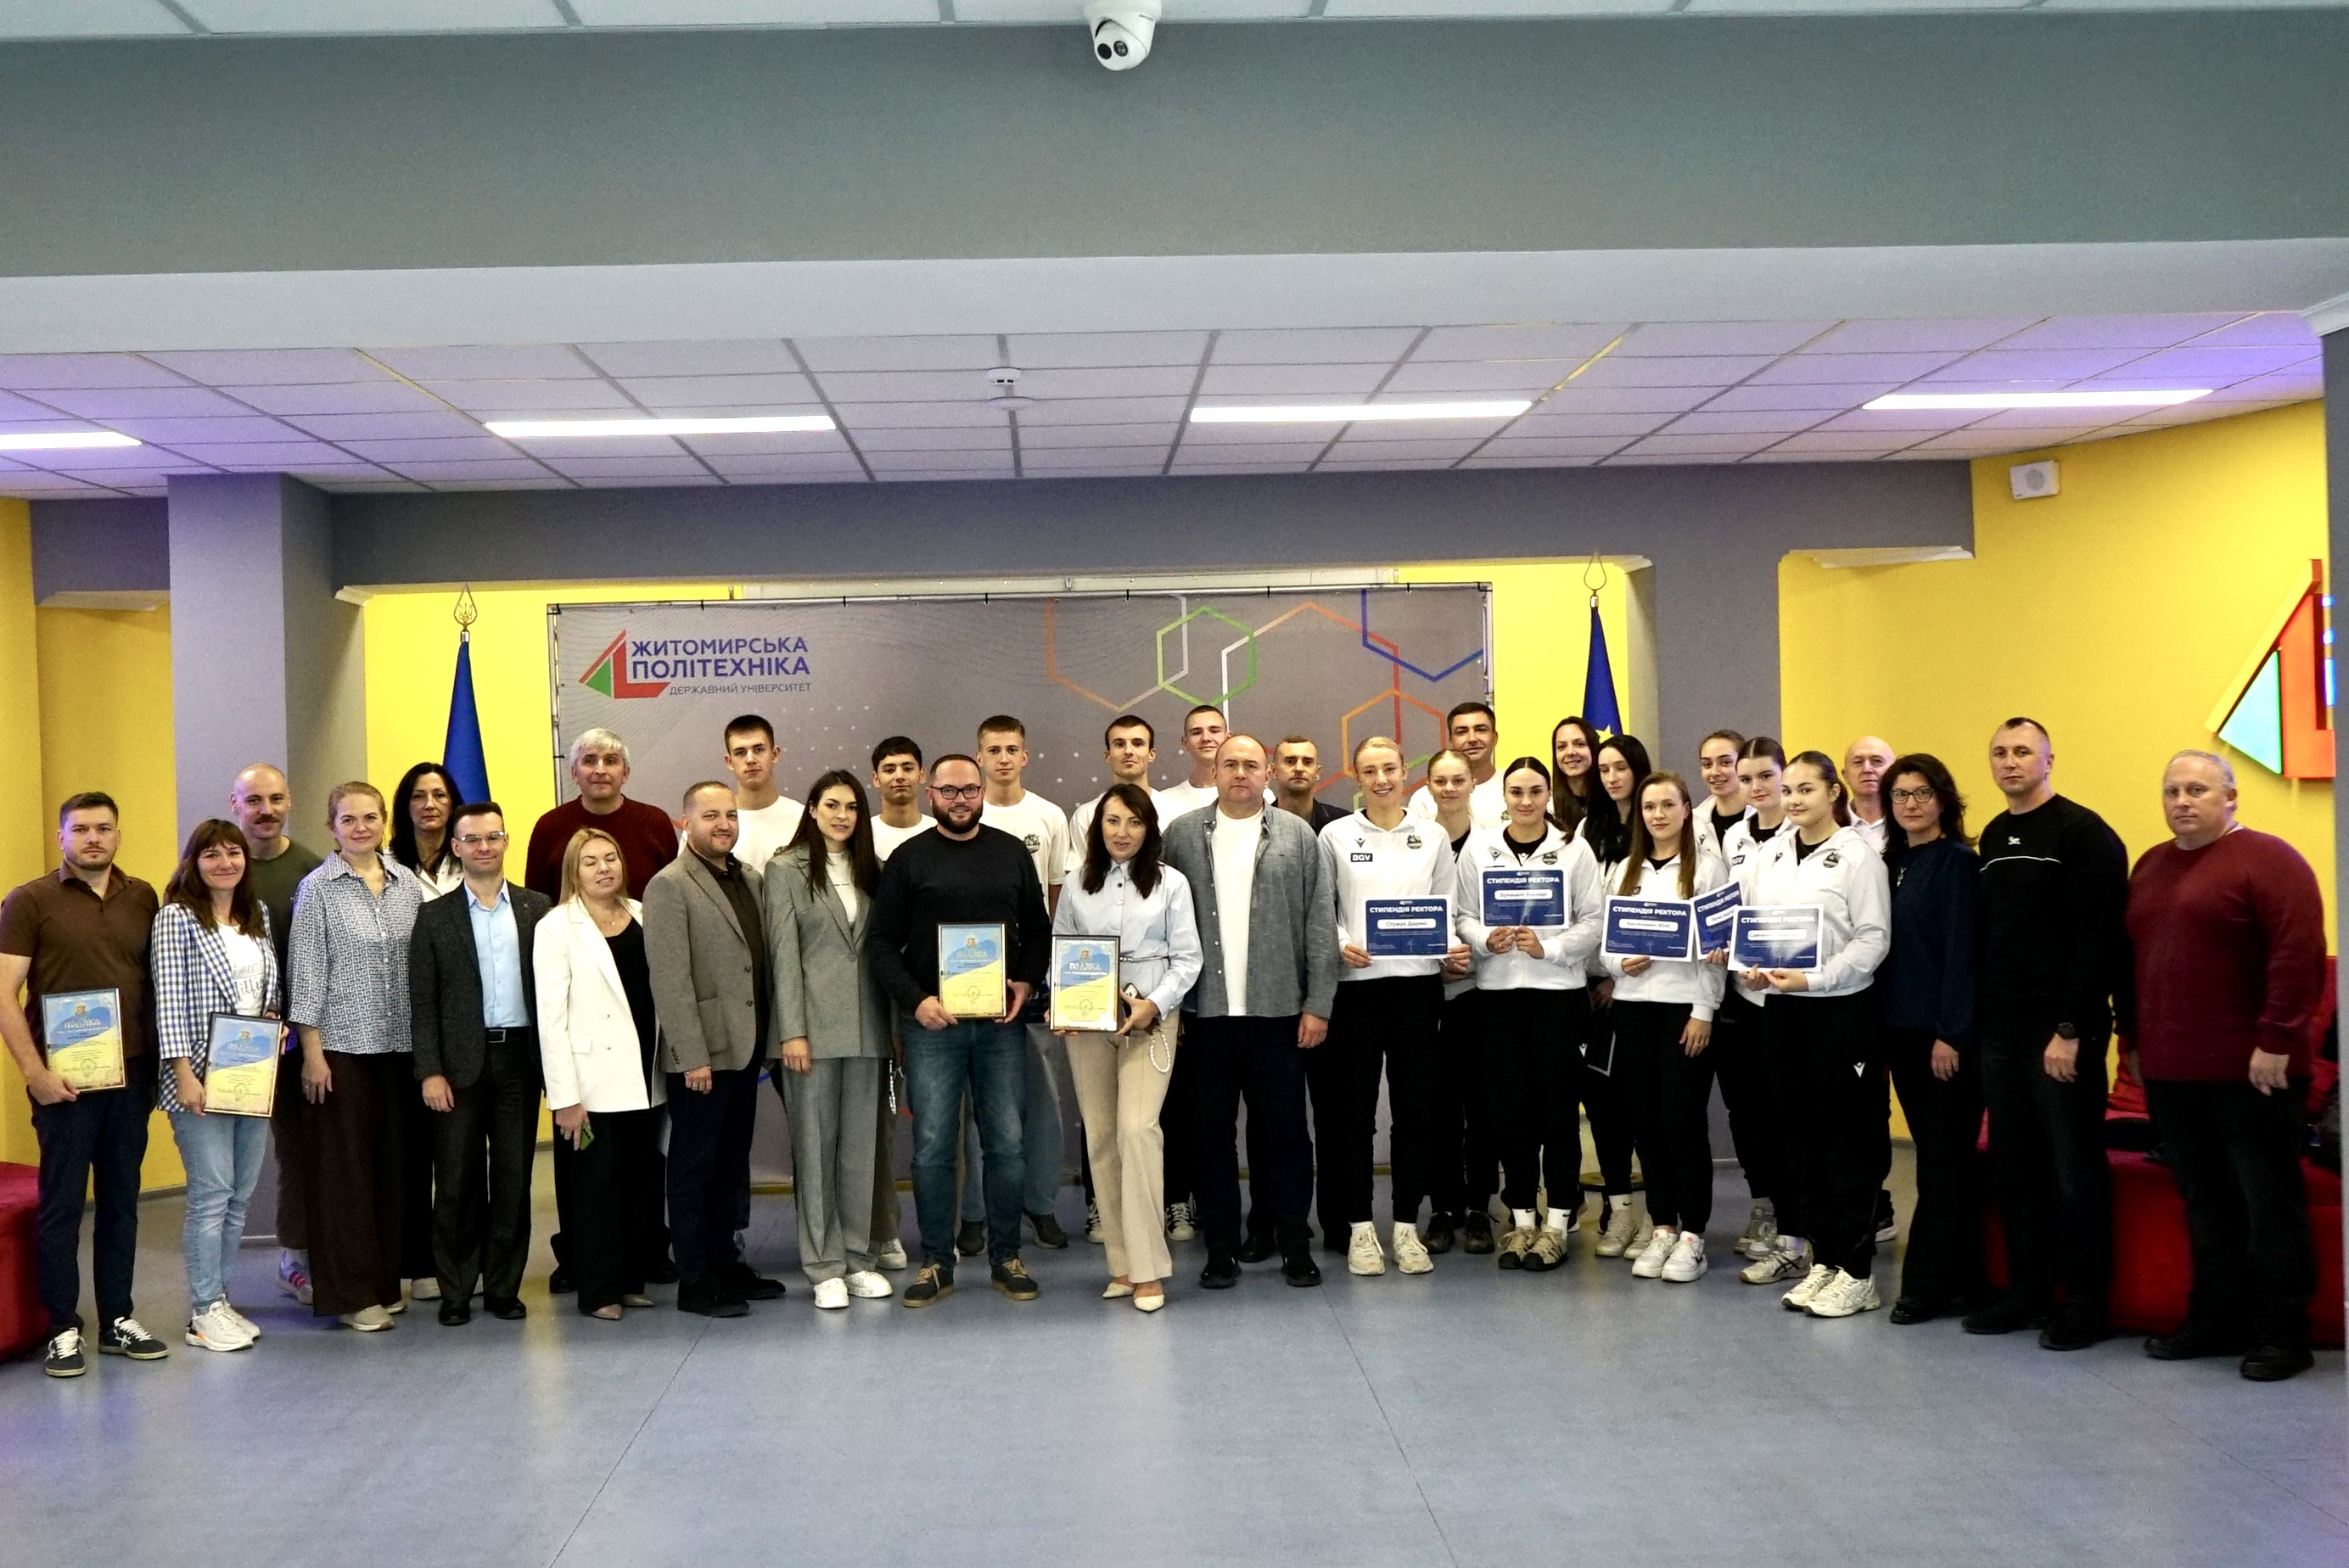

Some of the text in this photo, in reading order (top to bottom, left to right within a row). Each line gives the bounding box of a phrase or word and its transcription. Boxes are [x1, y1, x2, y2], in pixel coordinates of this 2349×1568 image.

[631, 637, 808, 657] ЖИТОМИРСЬКА
[632, 657, 810, 679] ПОЛІТЕХНІКА
[670, 682, 810, 696] ДЕРЖАВНИЙ УНІВЕРСИТЕТ
[1612, 905, 1687, 916] СТИПЕНДІЯ РЕКТОРА
